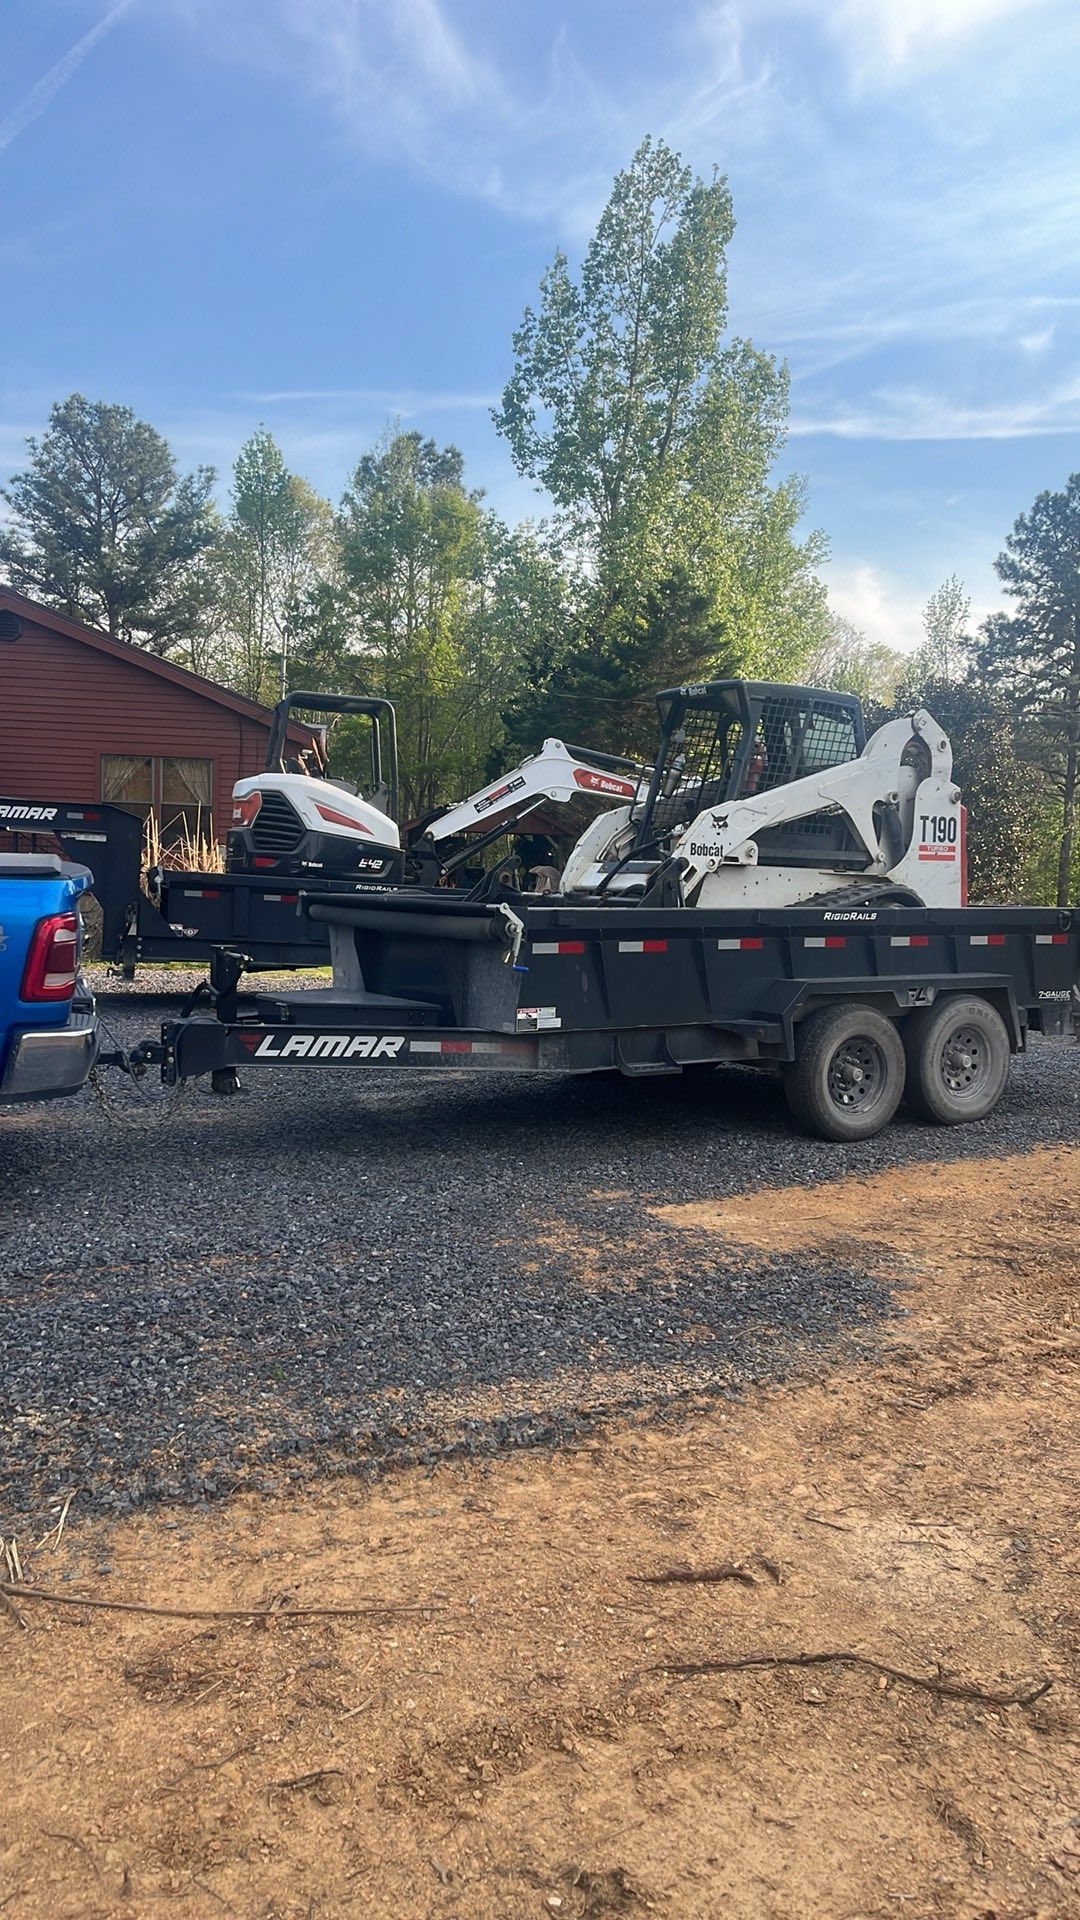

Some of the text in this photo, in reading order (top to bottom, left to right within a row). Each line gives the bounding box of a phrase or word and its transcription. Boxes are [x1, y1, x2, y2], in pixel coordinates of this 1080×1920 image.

[600, 780, 624, 793] Bobcat
[0, 805, 58, 820] AMAR
[920, 815, 957, 843] T190
[690, 842, 724, 857] Bobcat
[358, 858, 383, 869] E42
[823, 911, 878, 921] RIGIDRAILS
[254, 1034, 406, 1058] LAMAR
